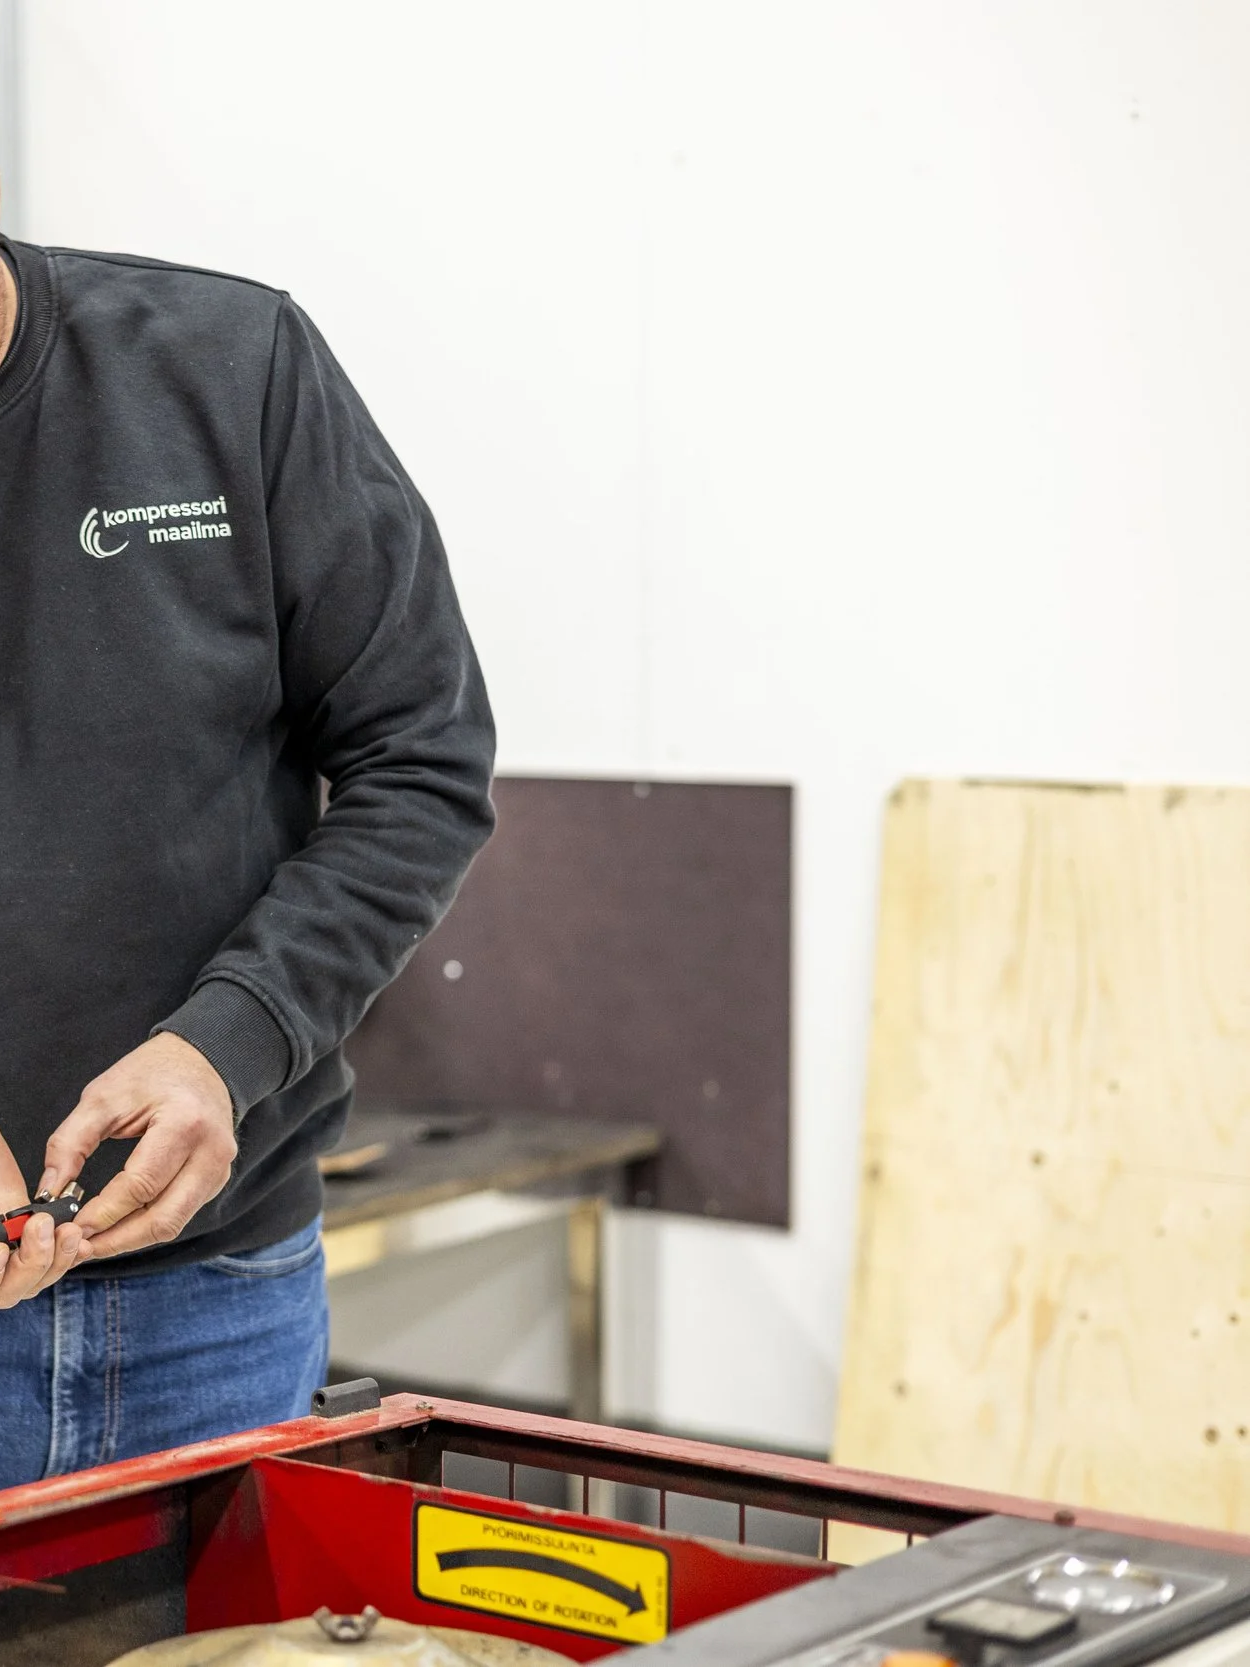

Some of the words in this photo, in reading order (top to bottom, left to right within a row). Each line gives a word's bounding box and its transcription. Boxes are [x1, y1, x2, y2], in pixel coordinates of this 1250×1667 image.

[102, 495, 227, 526] kompressori
[148, 521, 232, 544] maailma
[460, 1583, 527, 1609] DIRECTION
[532, 1598, 550, 1613] OF
[553, 1604, 617, 1628] ROTATION
